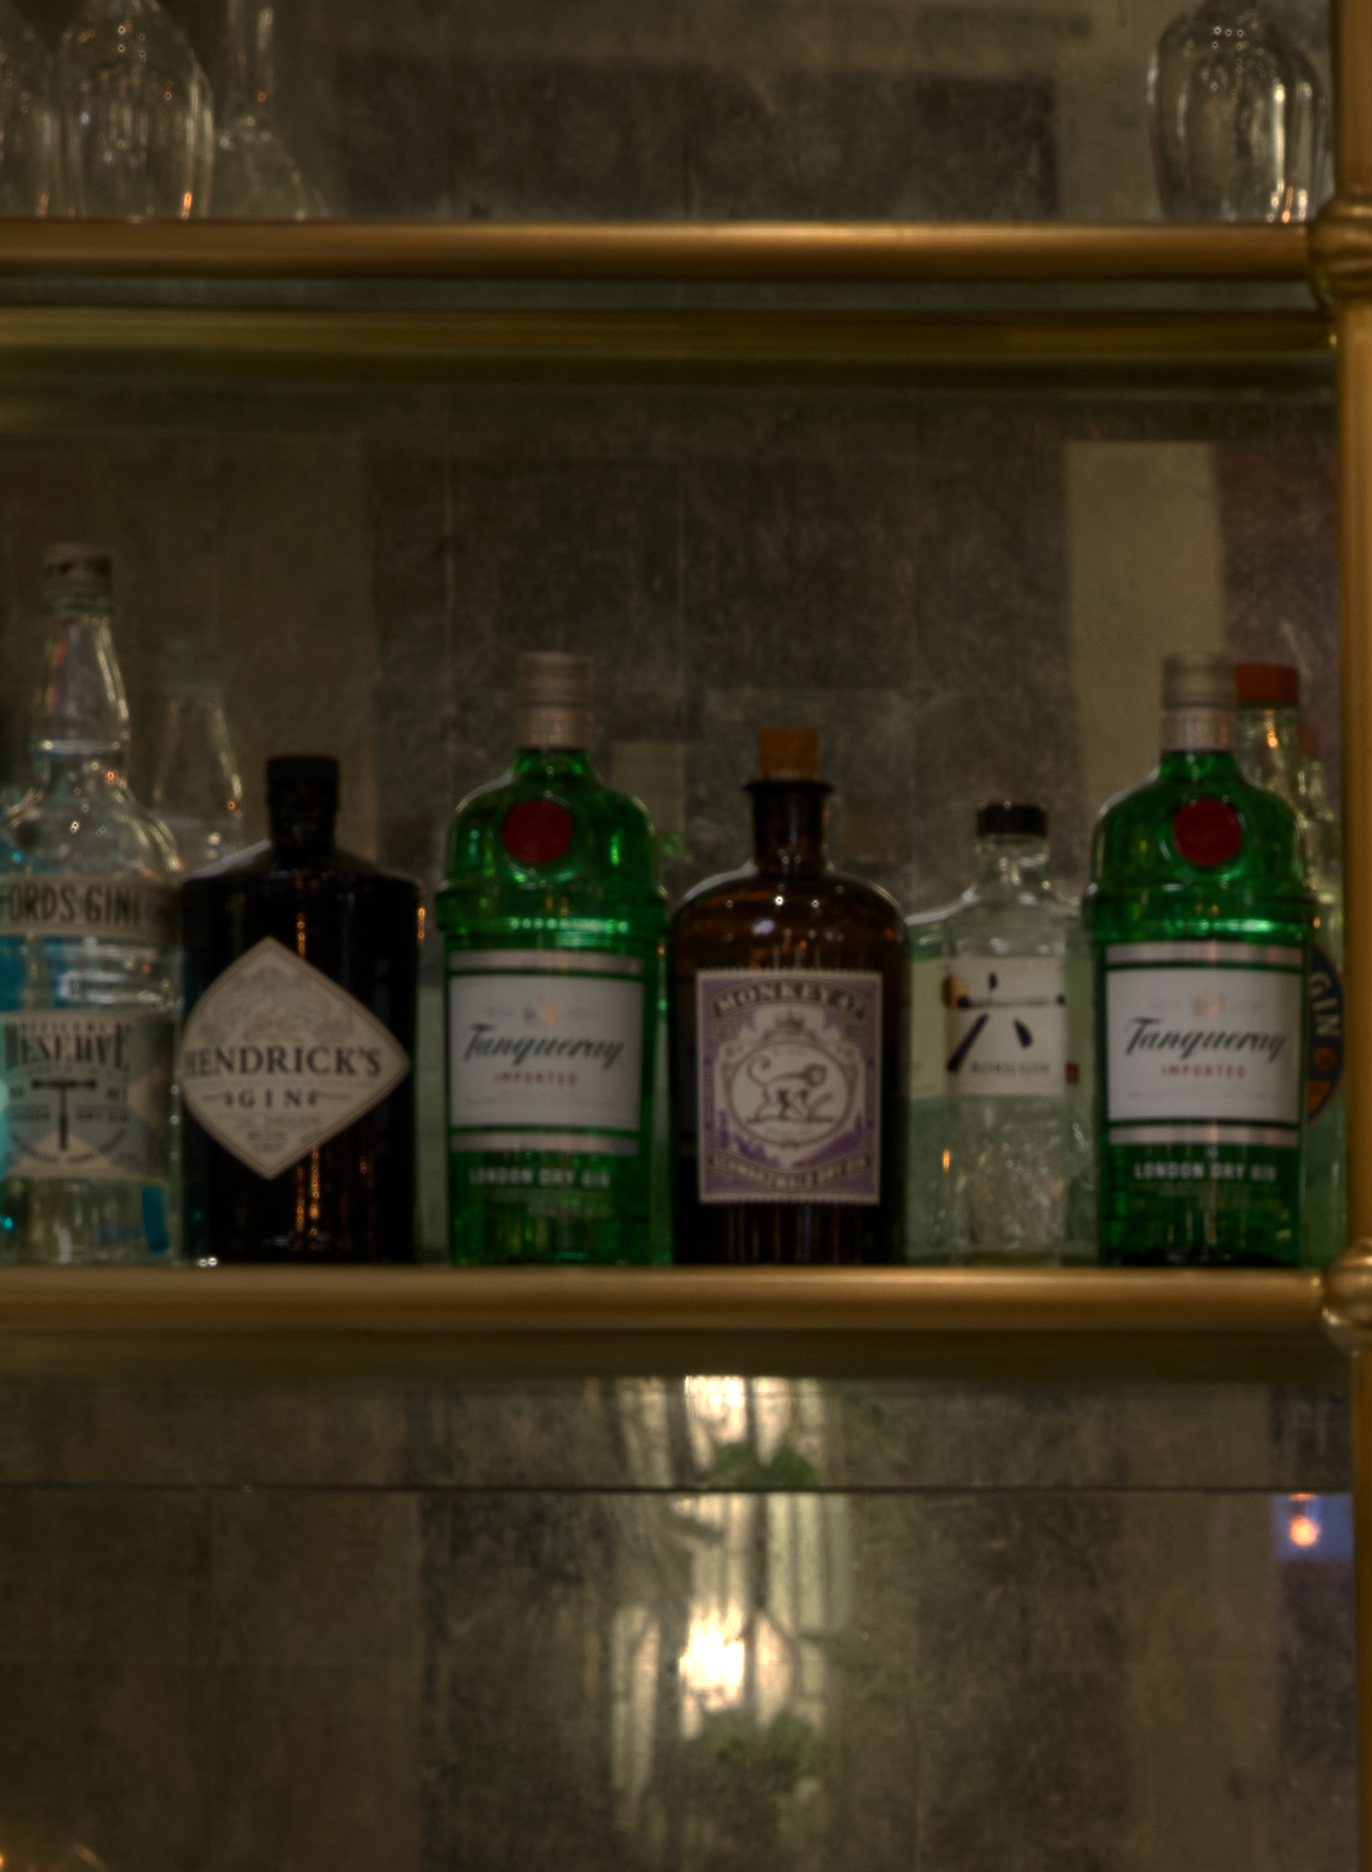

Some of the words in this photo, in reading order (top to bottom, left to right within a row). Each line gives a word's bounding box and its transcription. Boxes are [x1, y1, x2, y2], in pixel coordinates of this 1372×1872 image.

[1308, 971, 1342, 1038] GIN
[462, 1023, 626, 1070] Tanqueray
[1124, 1017, 1287, 1064] Tanqueray
[183, 1045, 382, 1078] HENDRICK'S
[239, 1089, 302, 1109] GIN
[1134, 1161, 1205, 1180] LONDON
[1209, 1161, 1246, 1180] DRY
